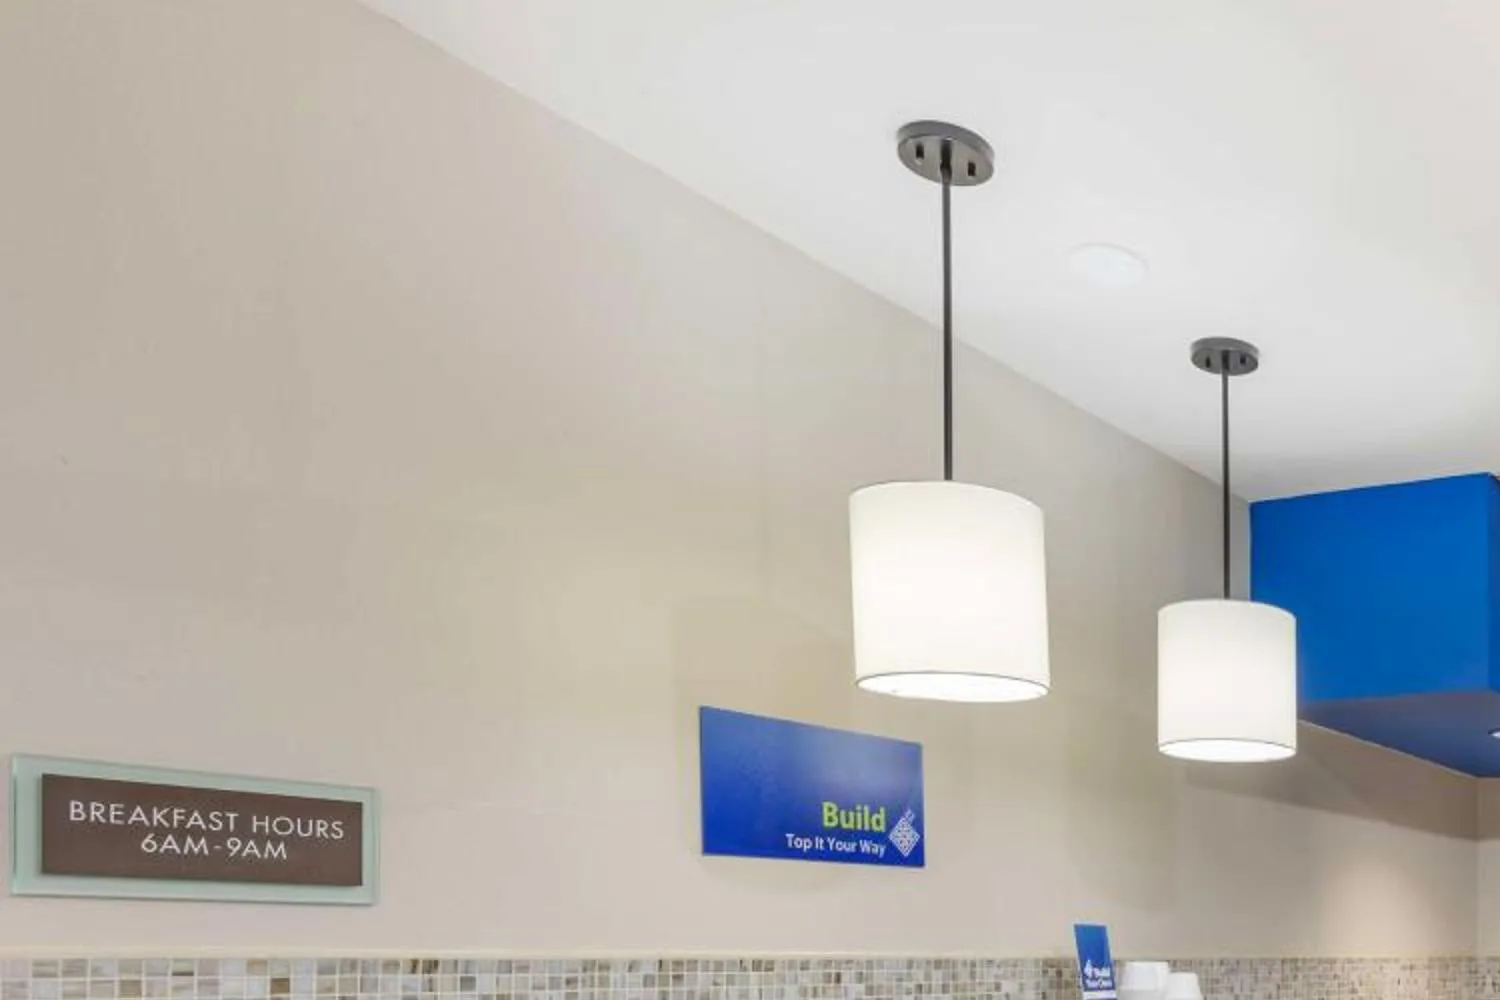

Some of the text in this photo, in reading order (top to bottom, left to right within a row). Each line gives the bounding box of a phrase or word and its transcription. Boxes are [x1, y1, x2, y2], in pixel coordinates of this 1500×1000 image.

[68, 800, 345, 840] BREAKFAST HOURS
[822, 801, 886, 832] Build
[785, 833, 813, 852] Top
[826, 837, 856, 852] Your
[859, 840, 887, 857] Way
